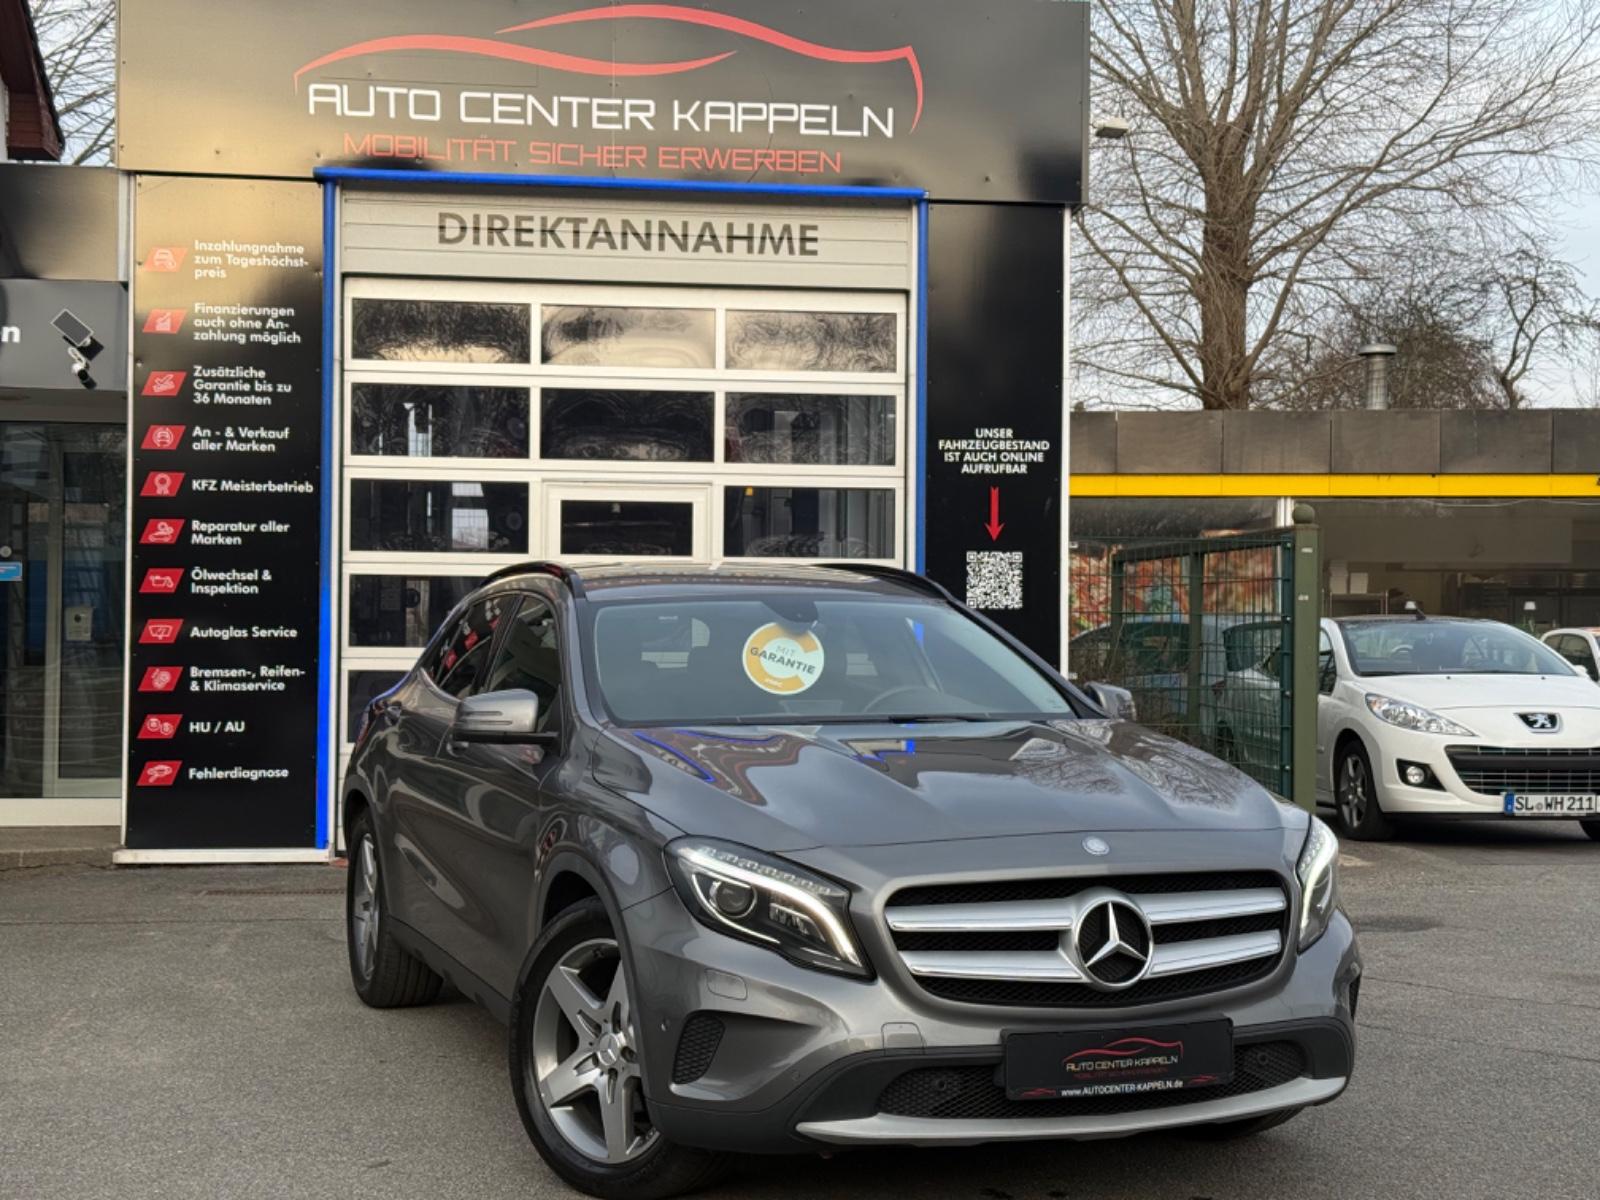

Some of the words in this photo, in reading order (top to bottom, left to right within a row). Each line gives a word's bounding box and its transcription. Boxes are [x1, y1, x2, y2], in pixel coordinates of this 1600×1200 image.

[308, 82, 441, 121] AUTO
[460, 91, 655, 130] CENTER
[673, 98, 895, 138] KAPPELN
[342, 132, 518, 163] MOBILITÄT
[529, 141, 648, 168] SICHER
[658, 147, 842, 174] ERWERBEN
[437, 211, 820, 257] DIREKTANNAHME
[194, 240, 304, 255] Inzahlungnahme
[194, 255, 222, 265] zum
[226, 254, 309, 268] Tageshöchst-
[194, 267, 227, 280] preis
[194, 303, 295, 319] Finanzierungen
[193, 317, 225, 328] auch
[229, 318, 262, 329] ohne
[266, 319, 290, 329] An-
[193, 331, 247, 344] zahlung
[250, 332, 301, 345] möglich
[193, 365, 266, 378] Zusätzliche
[193, 380, 250, 392] Garantie
[255, 381, 273, 392] bis
[277, 383, 292, 392] zu
[193, 394, 210, 404] 36
[213, 394, 272, 406] Monaten
[224, 427, 234, 438] &
[238, 427, 290, 439] Verkauf
[975, 428, 1014, 438] UNSER
[192, 440, 222, 451] aller
[225, 441, 276, 452] Marken
[938, 440, 1050, 450] FAHRZEUGBESTAND
[944, 452, 960, 462] IST
[963, 452, 997, 462] AUCH
[1000, 452, 1044, 462] ONLINE
[961, 464, 1028, 474] AUFRUFBAR
[191, 479, 217, 491] KFZ
[220, 480, 314, 493] Meisterbetrieb
[191, 520, 257, 534] Reparatur
[260, 521, 290, 533] aller
[191, 534, 242, 545] Marken
[191, 566, 258, 581] Ölwechsel
[262, 570, 272, 581] &
[190, 582, 259, 597] Inspektion
[190, 626, 248, 640] Autoglas
[252, 626, 298, 638] Service
[775, 645, 796, 657] MIT
[750, 646, 816, 675] GARANTIE
[259, 665, 306, 677] Reifen-
[190, 681, 200, 692] &
[204, 679, 285, 692] Klimaservice
[189, 722, 211, 733] HU
[224, 721, 246, 733] AU
[188, 767, 290, 781] Fehlerdiagnose
[1515, 796, 1534, 811] SL
[1544, 796, 1564, 811] WH
[1567, 796, 1594, 811] 211
[1066, 1062, 1094, 1072] AUTO
[1095, 1058, 1134, 1070] CENTER
[1135, 1055, 1179, 1067] KAPPELN
[1061, 1080, 1184, 1097] www.AUTOCENTER-KAPPELN.de
